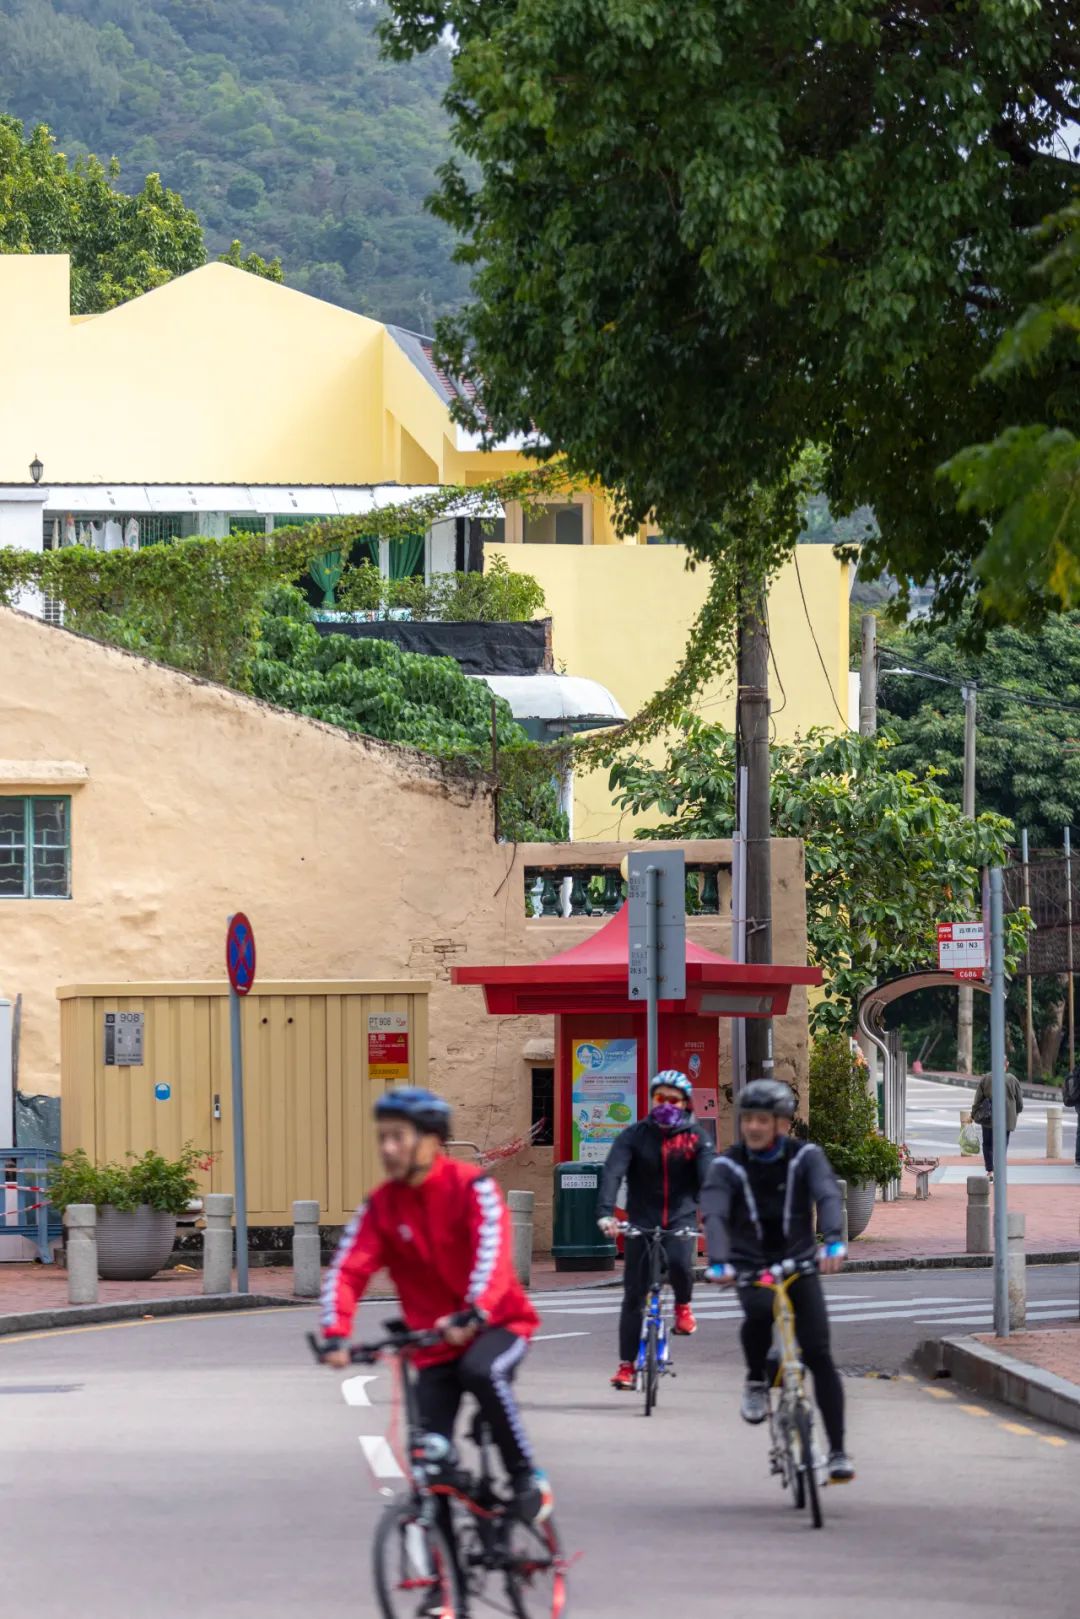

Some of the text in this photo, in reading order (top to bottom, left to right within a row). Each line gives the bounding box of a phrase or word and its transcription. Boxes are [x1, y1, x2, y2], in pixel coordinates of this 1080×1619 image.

[120, 1013, 140, 1022] 908
[369, 1017, 391, 1025] PT 908
